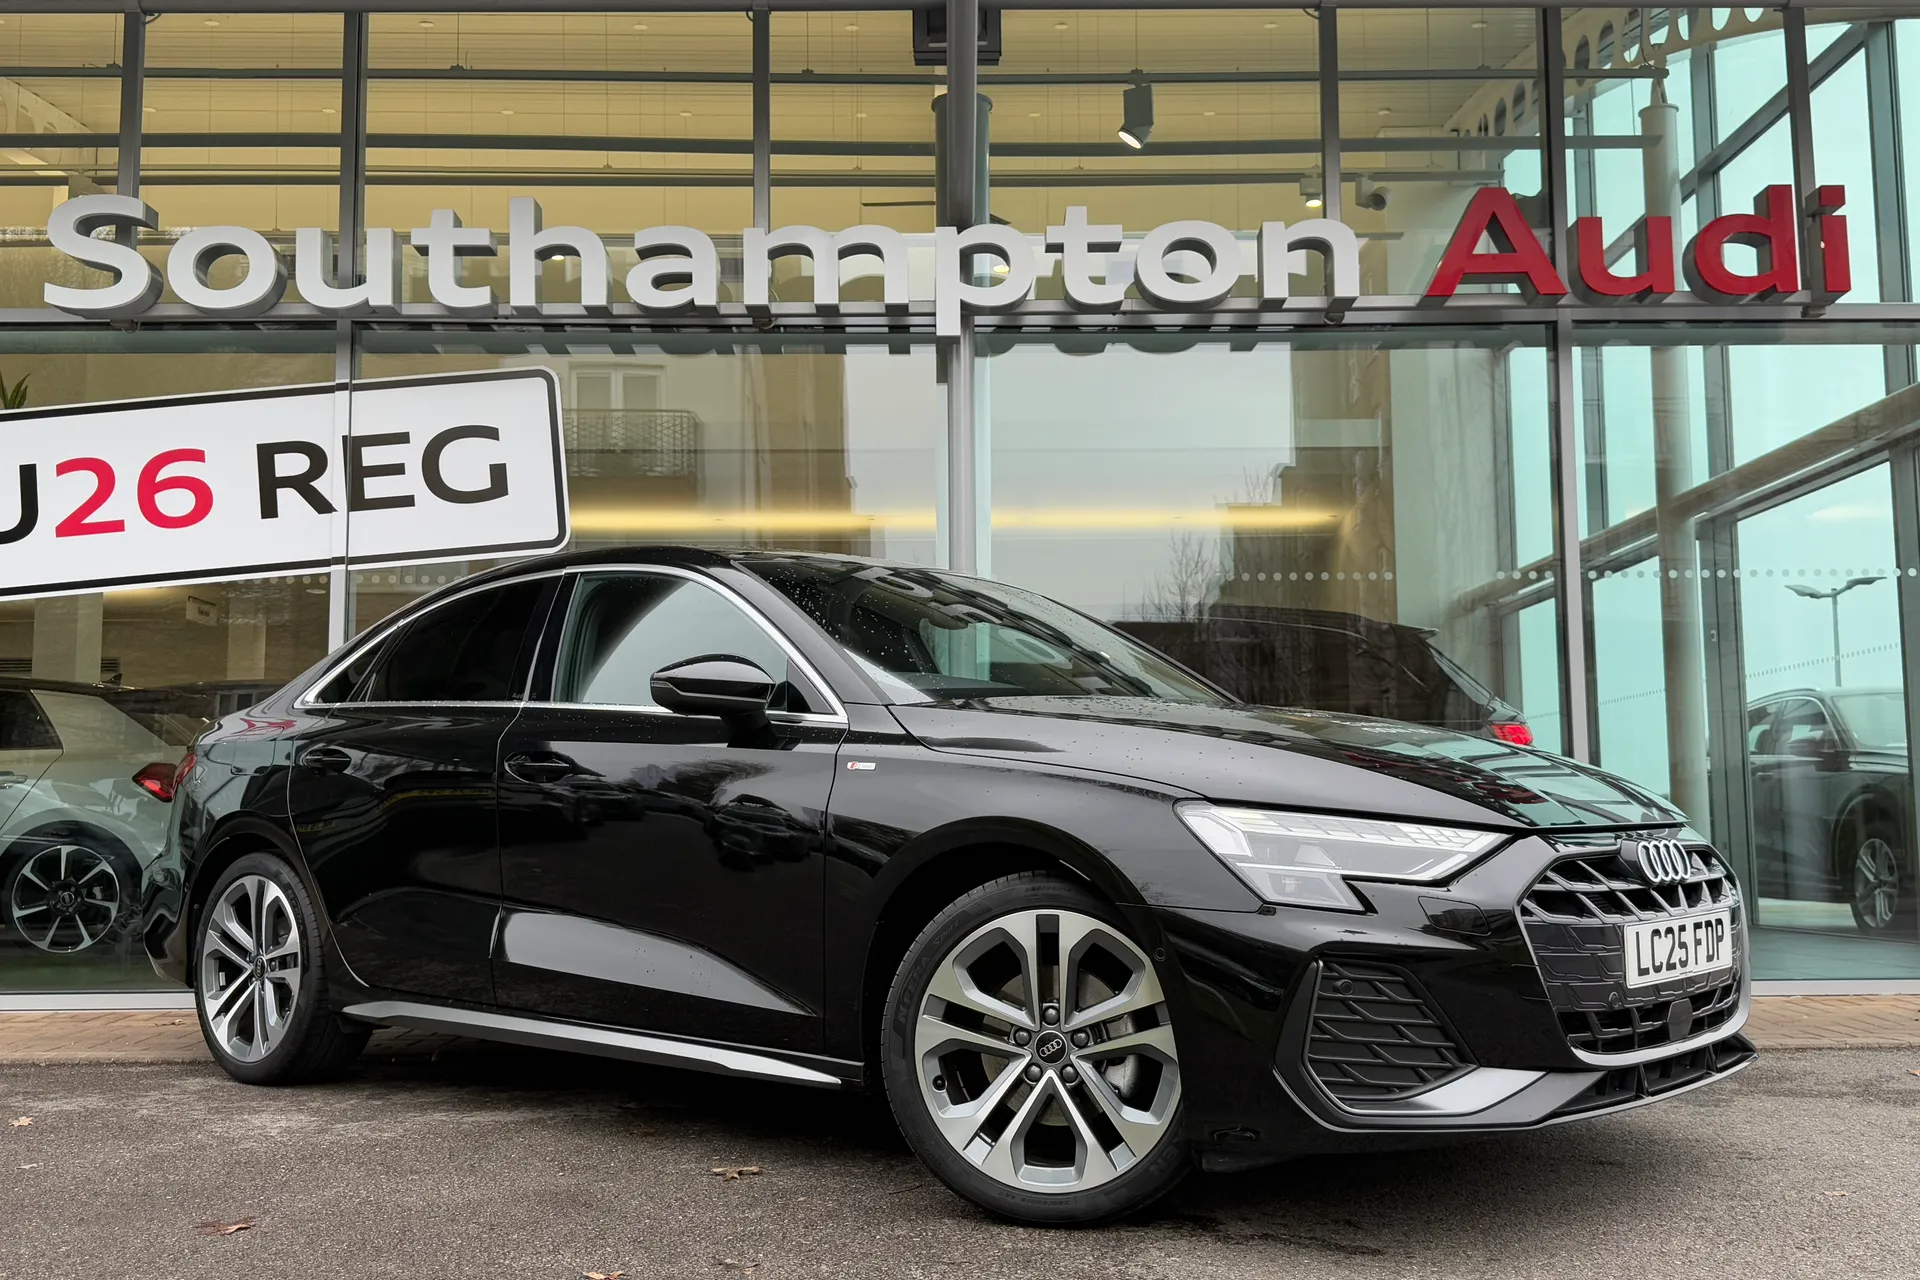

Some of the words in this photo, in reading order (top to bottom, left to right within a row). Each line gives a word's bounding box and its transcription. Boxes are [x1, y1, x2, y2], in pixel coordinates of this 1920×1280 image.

[43, 194, 1360, 337] Southampton
[1424, 184, 1851, 296] Audi
[257, 424, 509, 519] REG
[1635, 924, 1689, 977] LC25
[1693, 918, 1724, 965] FDP
